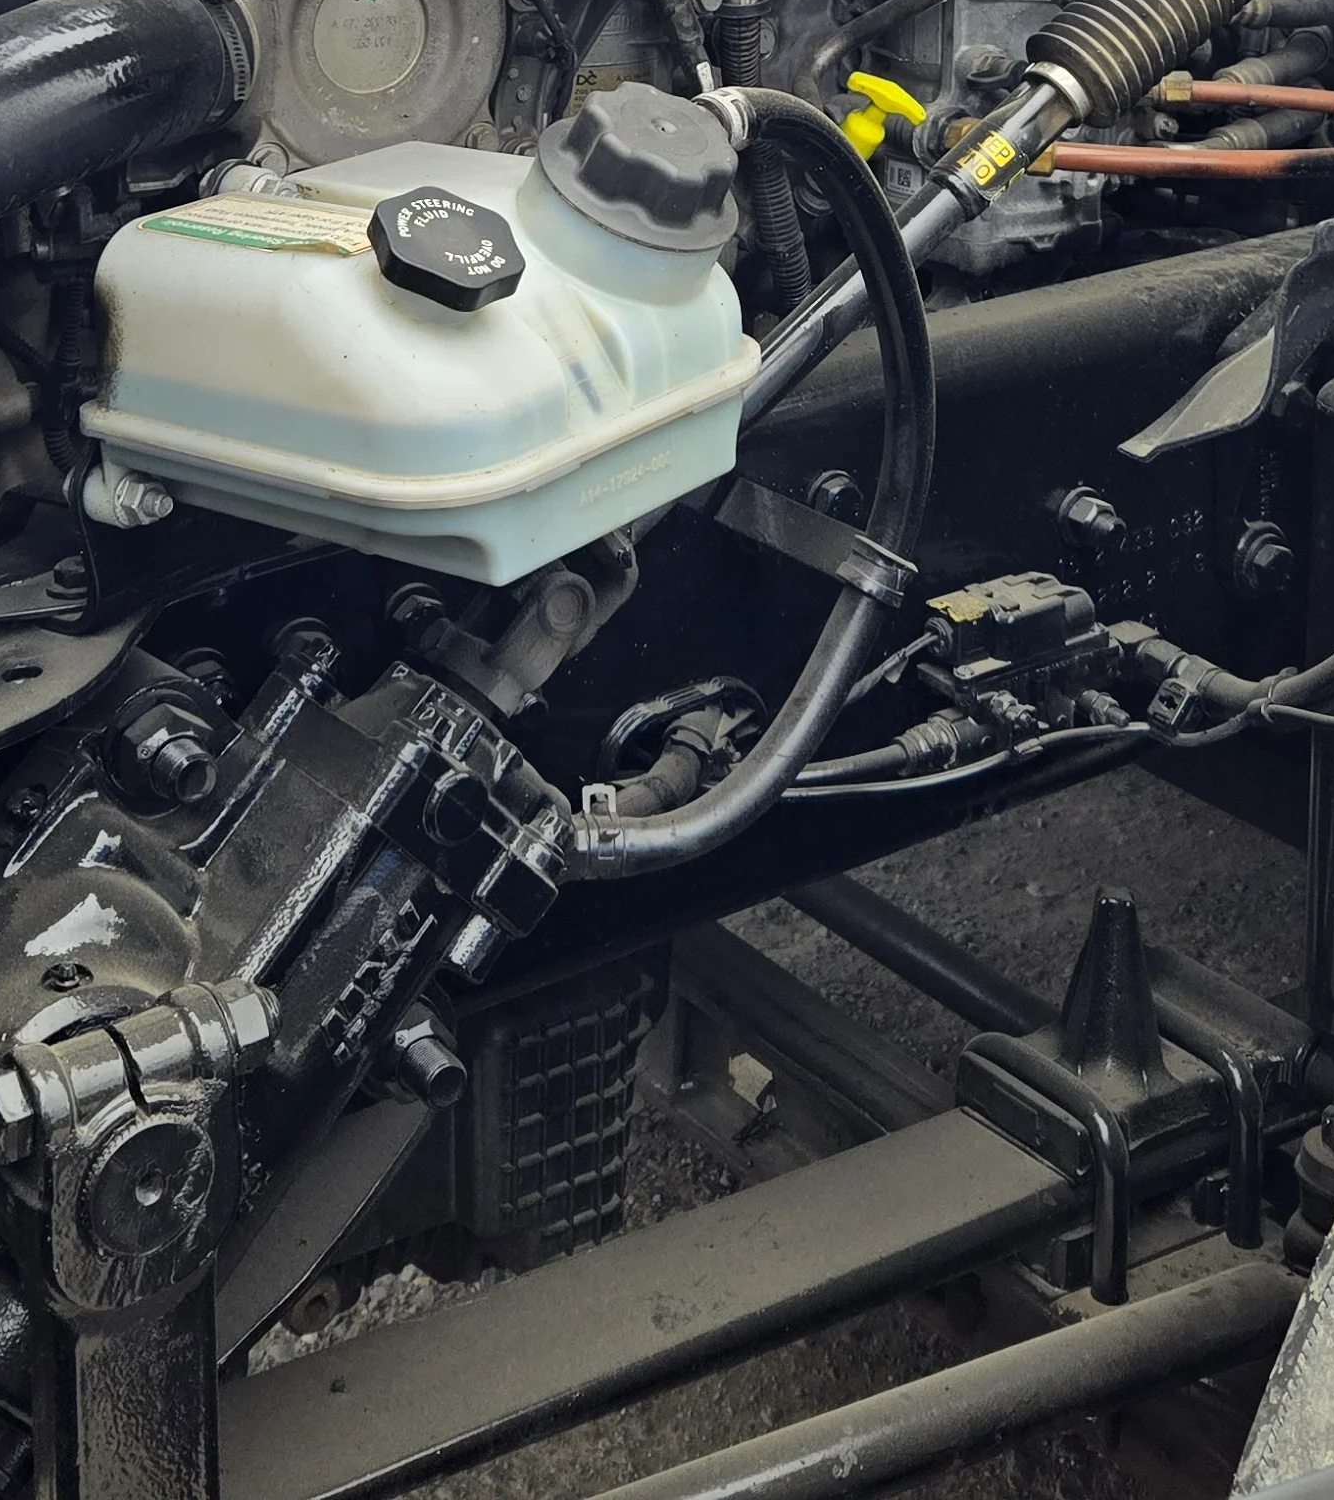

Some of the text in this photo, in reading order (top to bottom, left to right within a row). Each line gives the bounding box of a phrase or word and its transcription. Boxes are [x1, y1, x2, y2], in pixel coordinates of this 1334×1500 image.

[397, 199, 475, 238] POWER STEERING
[414, 210, 449, 228] FLUID
[445, 239, 494, 264] OVERFILL
[467, 255, 506, 276] DO NOT
